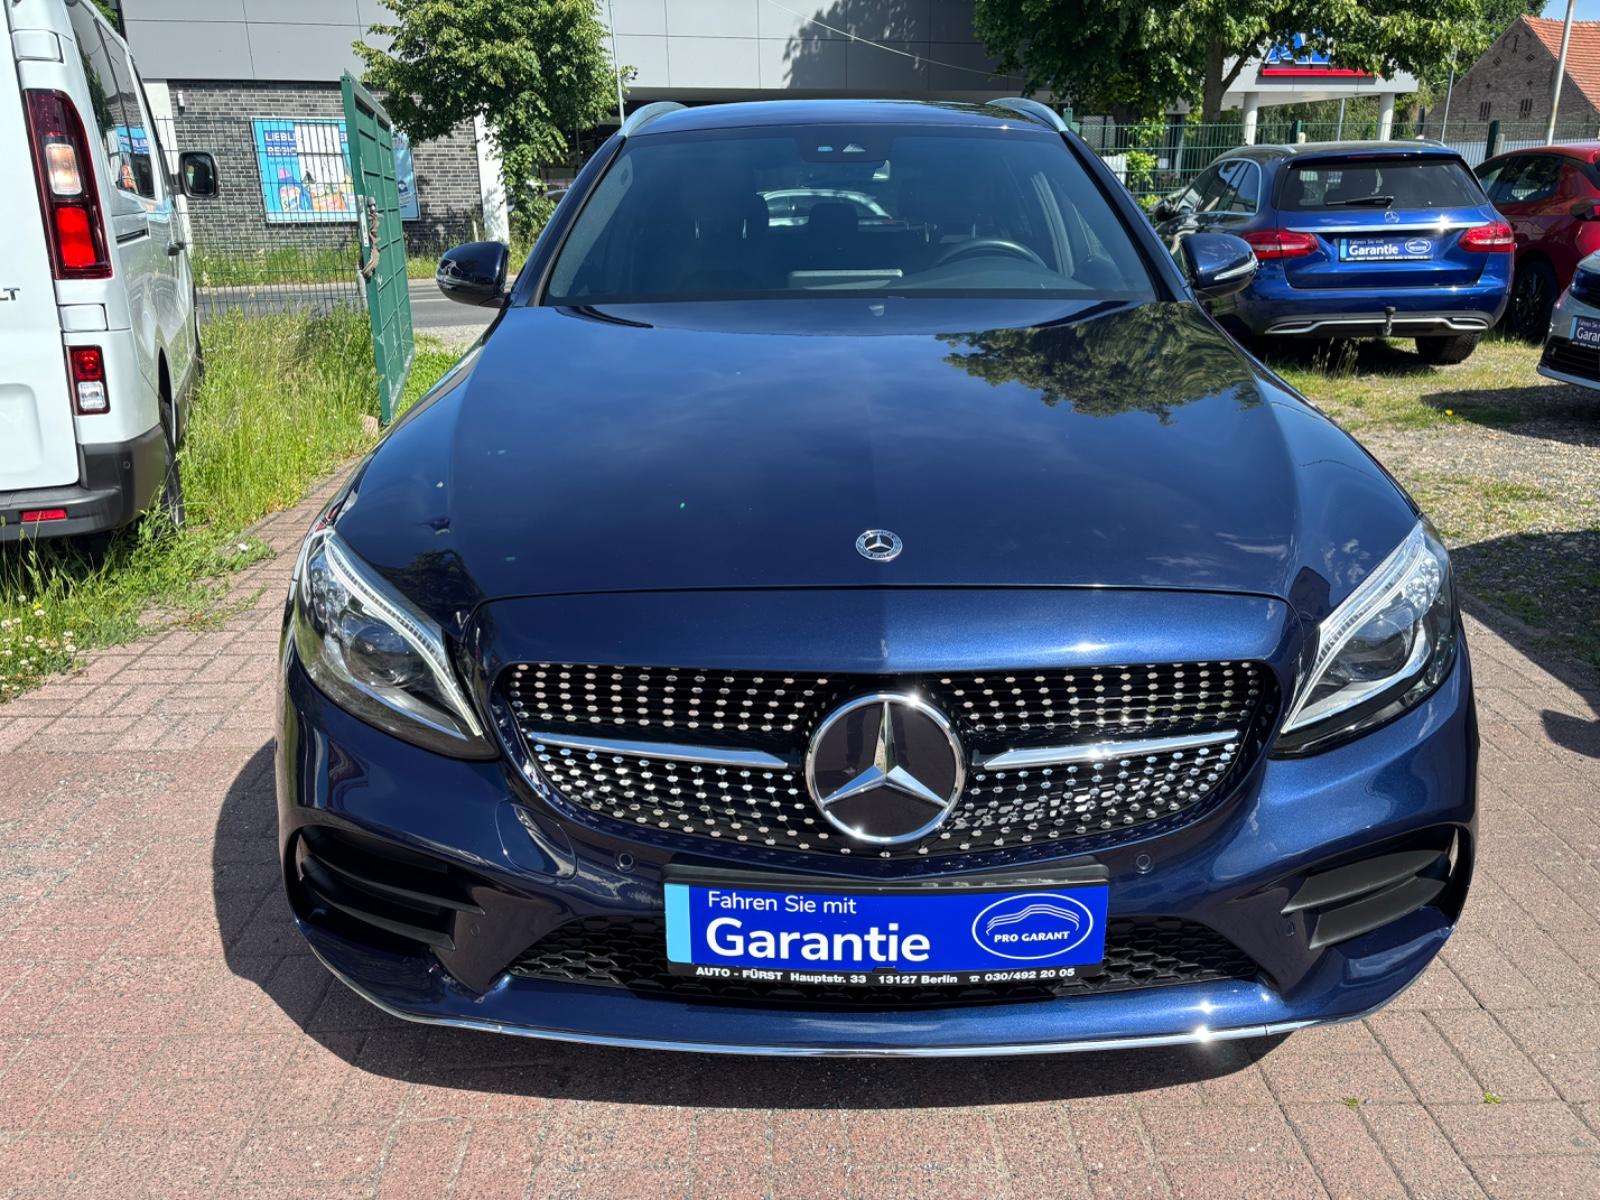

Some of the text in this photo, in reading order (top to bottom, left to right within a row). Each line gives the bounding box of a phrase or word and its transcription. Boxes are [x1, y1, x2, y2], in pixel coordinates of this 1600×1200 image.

[1349, 244, 1398, 255] Garantie
[708, 890, 857, 914] Fahren Sie mit
[706, 917, 931, 962] Garantie
[994, 931, 1070, 943] PRO GARANT
[696, 966, 730, 977] AUTO
[742, 968, 783, 981] FÜRST
[790, 970, 846, 984] Hauptstr.
[850, 974, 867, 984] 33
[878, 975, 916, 985] 13127
[921, 975, 957, 985] Berlin
[984, 970, 1037, 982] 030/492
[1040, 968, 1056, 978] 20
[1059, 967, 1075, 977] 05
